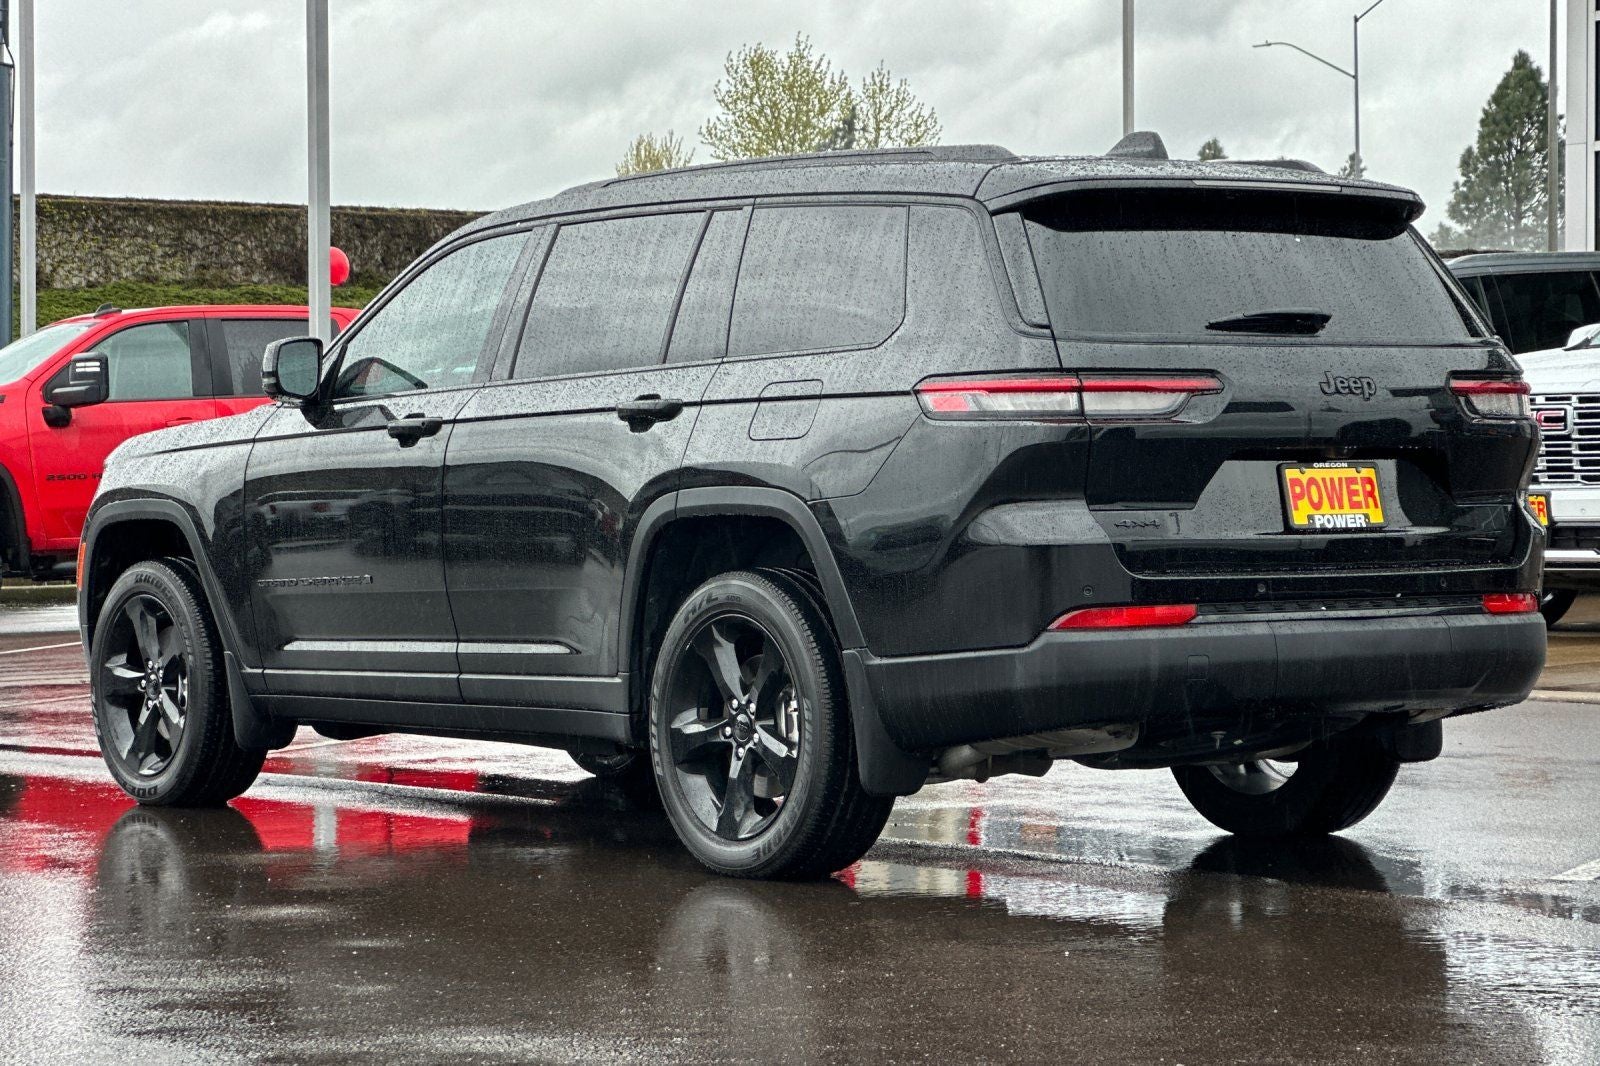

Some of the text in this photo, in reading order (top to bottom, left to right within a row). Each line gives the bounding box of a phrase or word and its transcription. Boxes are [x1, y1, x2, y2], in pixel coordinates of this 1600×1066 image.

[1319, 371, 1377, 401] Jeep
[46, 473, 87, 481] 2500
[1289, 477, 1380, 511] POWER
[1314, 514, 1367, 528] POWER
